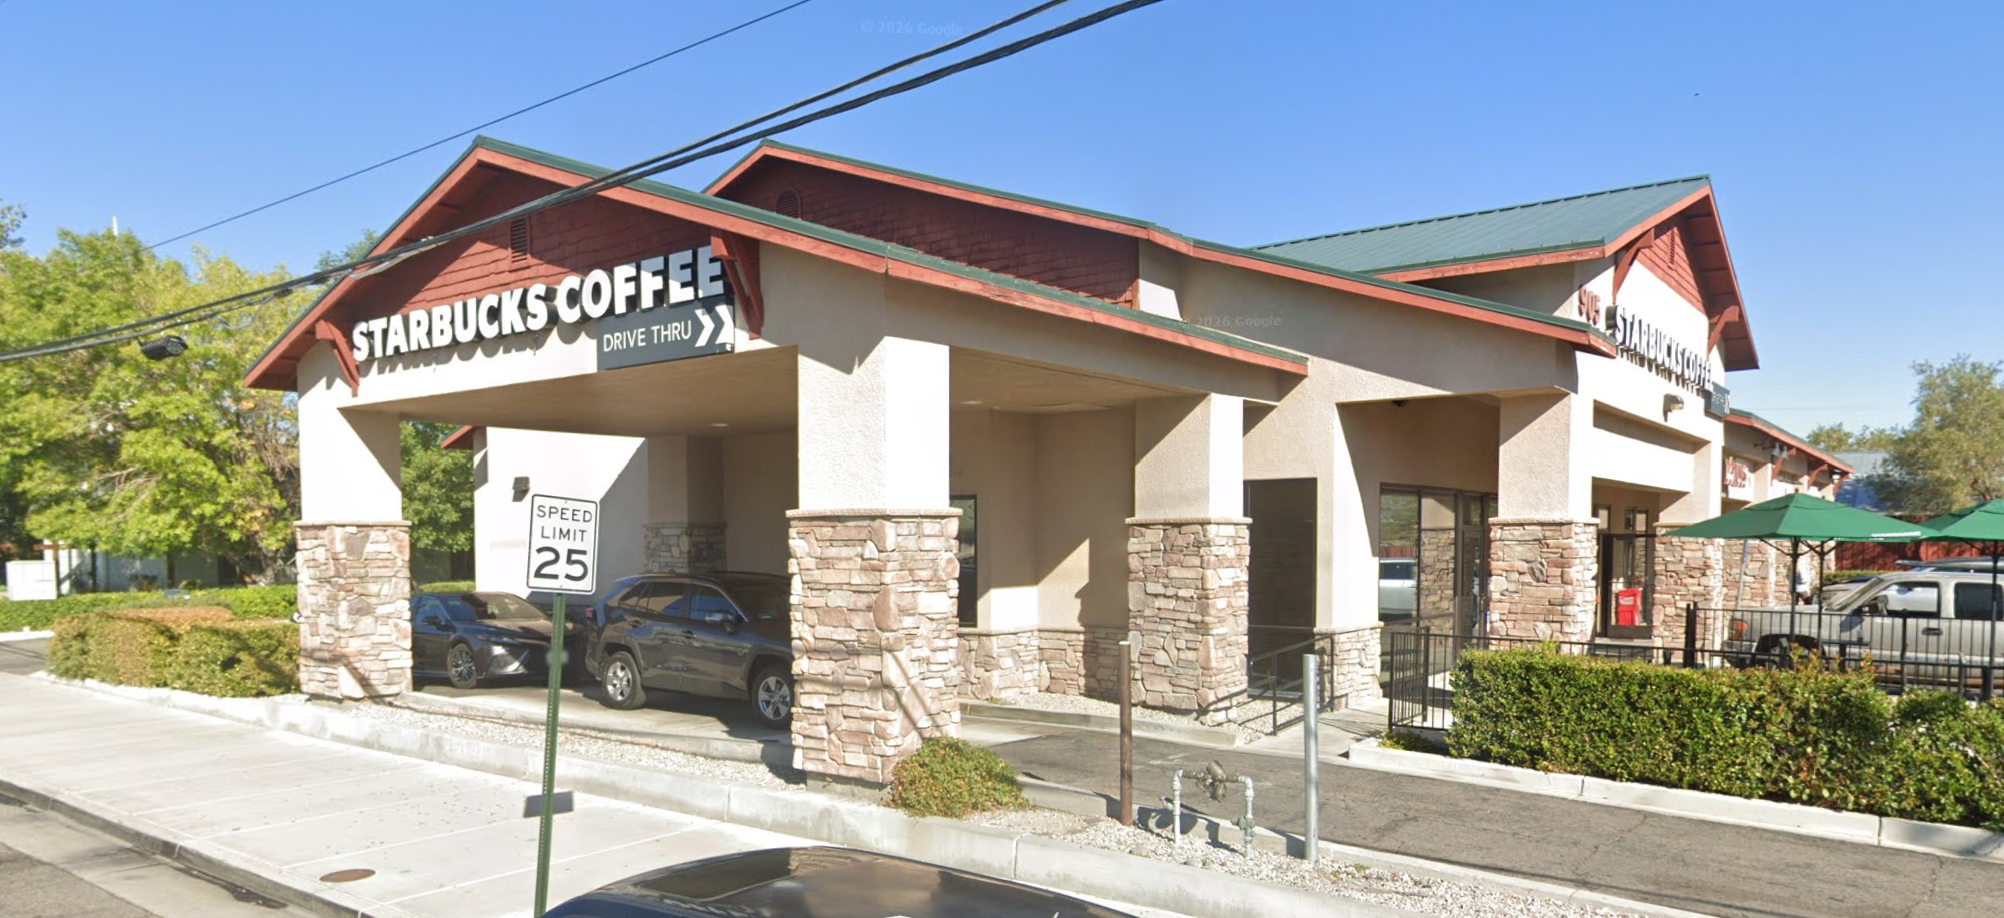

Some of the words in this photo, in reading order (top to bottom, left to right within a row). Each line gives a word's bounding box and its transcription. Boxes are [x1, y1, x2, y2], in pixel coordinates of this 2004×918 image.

[352, 282, 548, 362] STARBUCKS
[556, 245, 725, 324] COFFEE
[1578, 284, 1601, 326] 905
[603, 327, 646, 353] DRIVE
[650, 319, 692, 344] THRU
[1614, 304, 1683, 376] STARBUCKS
[536, 504, 593, 523] SPEED
[541, 525, 587, 543] LIMIT
[533, 546, 589, 582] 25
